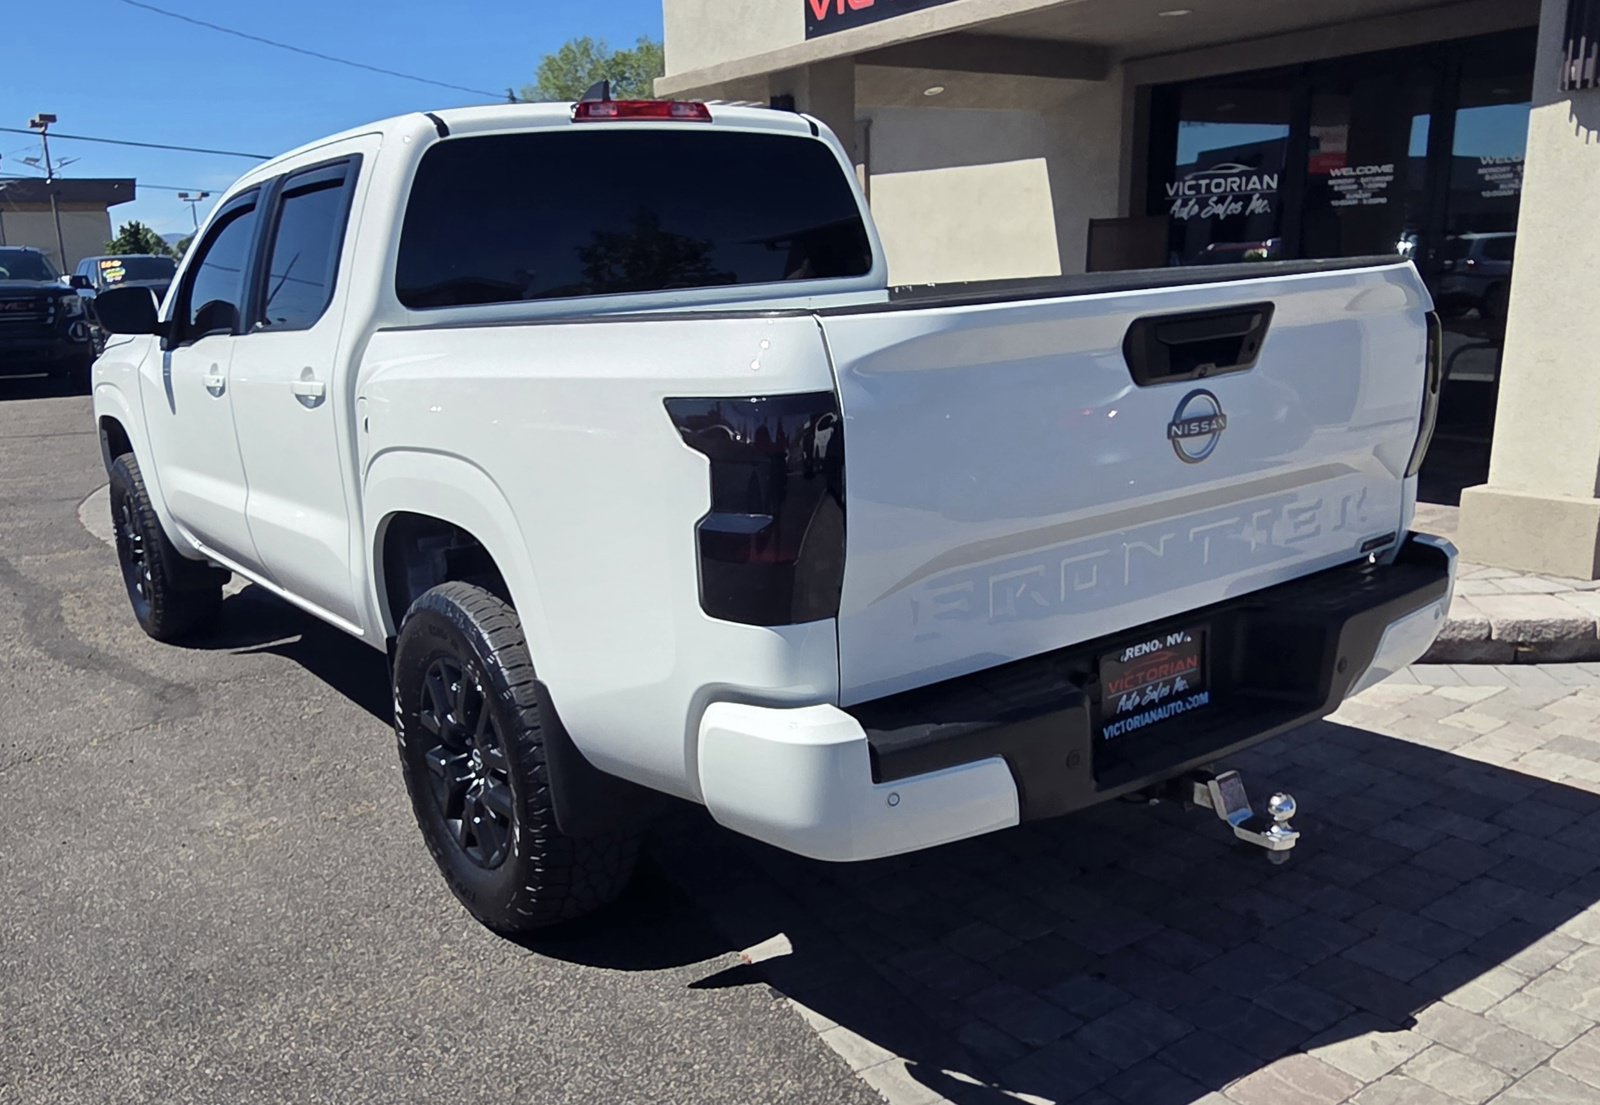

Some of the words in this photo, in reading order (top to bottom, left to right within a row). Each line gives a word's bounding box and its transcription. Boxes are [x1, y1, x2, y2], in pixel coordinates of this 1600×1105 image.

[1165, 173, 1278, 196] VICTORIAN
[1330, 164, 1394, 177] WELCOME
[1170, 198, 1200, 220] Auto
[1200, 195, 1244, 220] Sales
[1171, 417, 1226, 437] NISSAN
[911, 485, 1369, 637] FRONTIER
[1108, 655, 1198, 694] VICTORIAN
[1116, 691, 1140, 714] Auto
[1141, 682, 1170, 706] Sales
[1103, 691, 1209, 740] VICTORIANAUTO.COM
